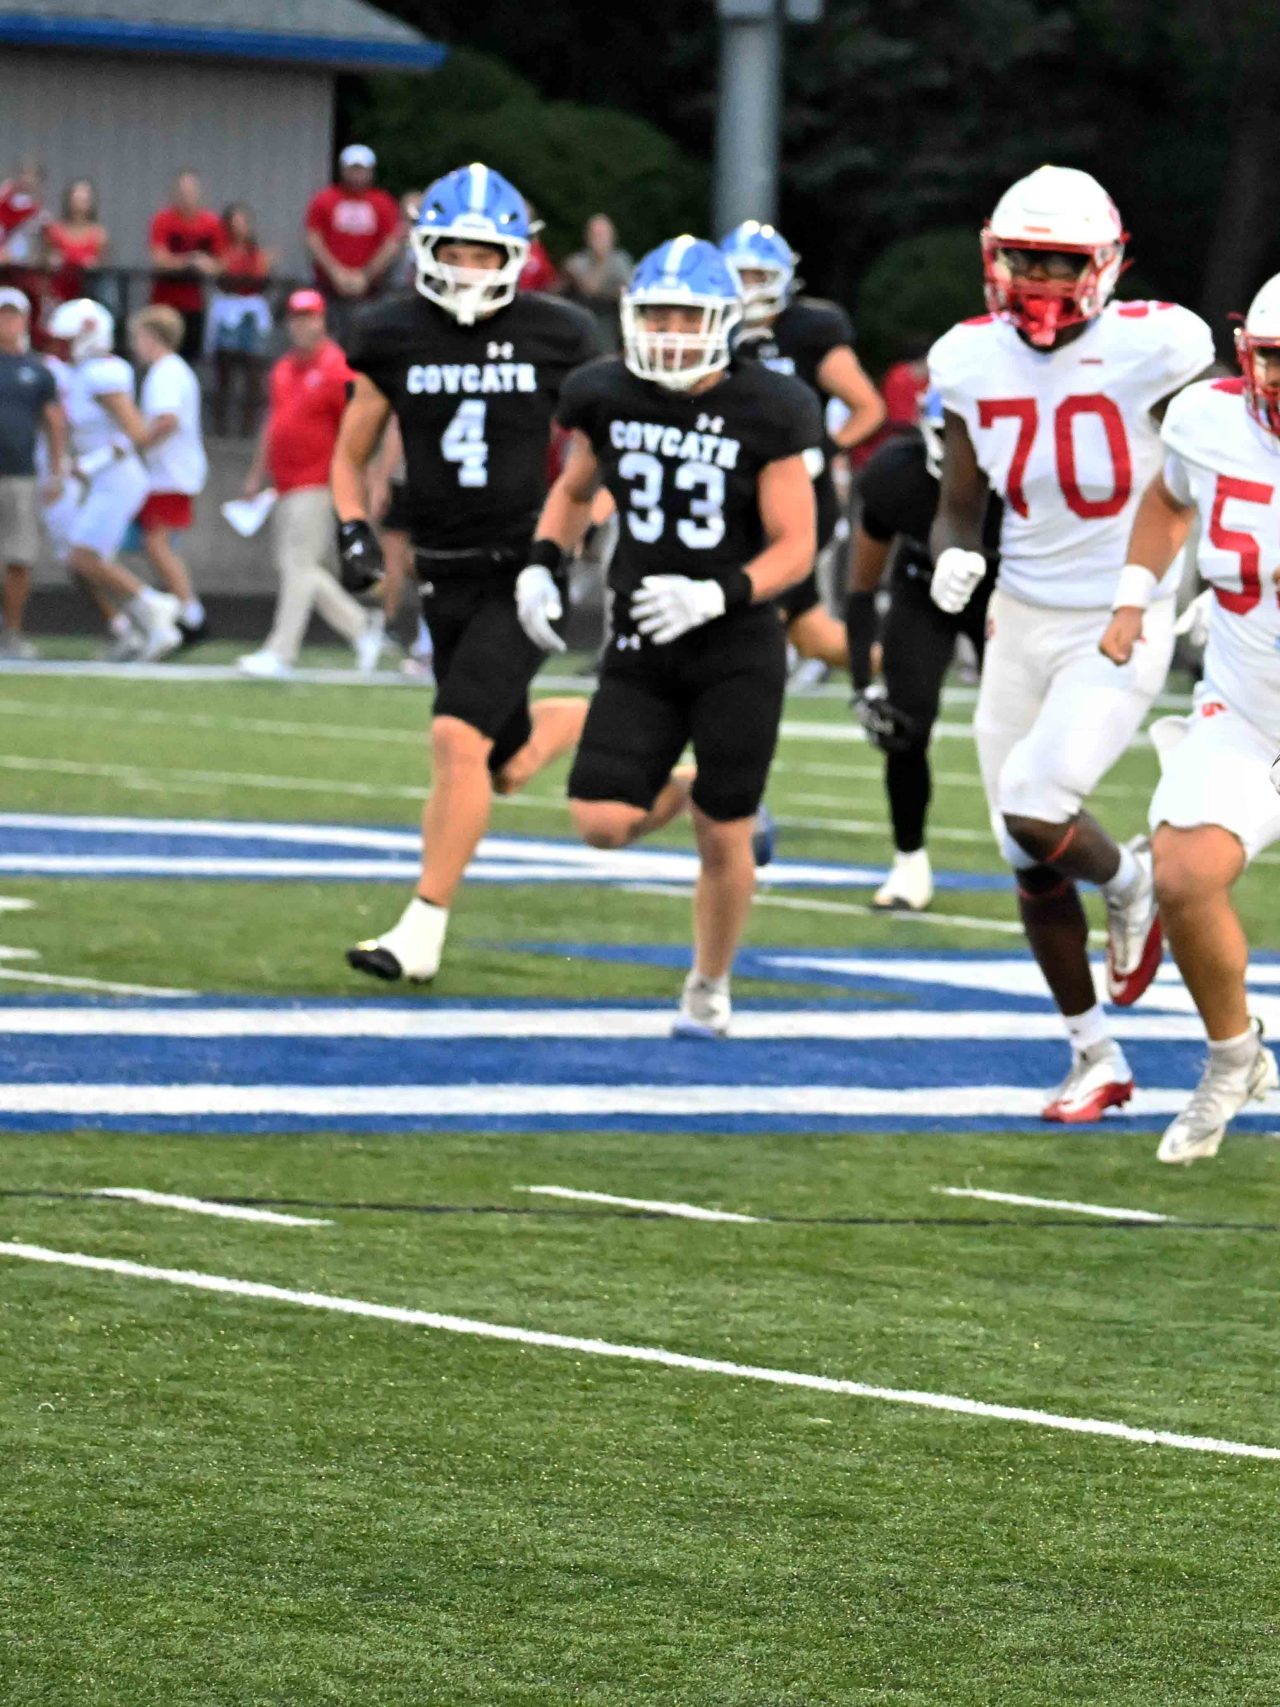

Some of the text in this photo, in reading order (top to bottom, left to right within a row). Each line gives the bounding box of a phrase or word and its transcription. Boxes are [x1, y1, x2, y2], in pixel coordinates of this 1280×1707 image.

[440, 399, 489, 488] 4
[978, 392, 1132, 520] 70
[618, 451, 726, 549] 33
